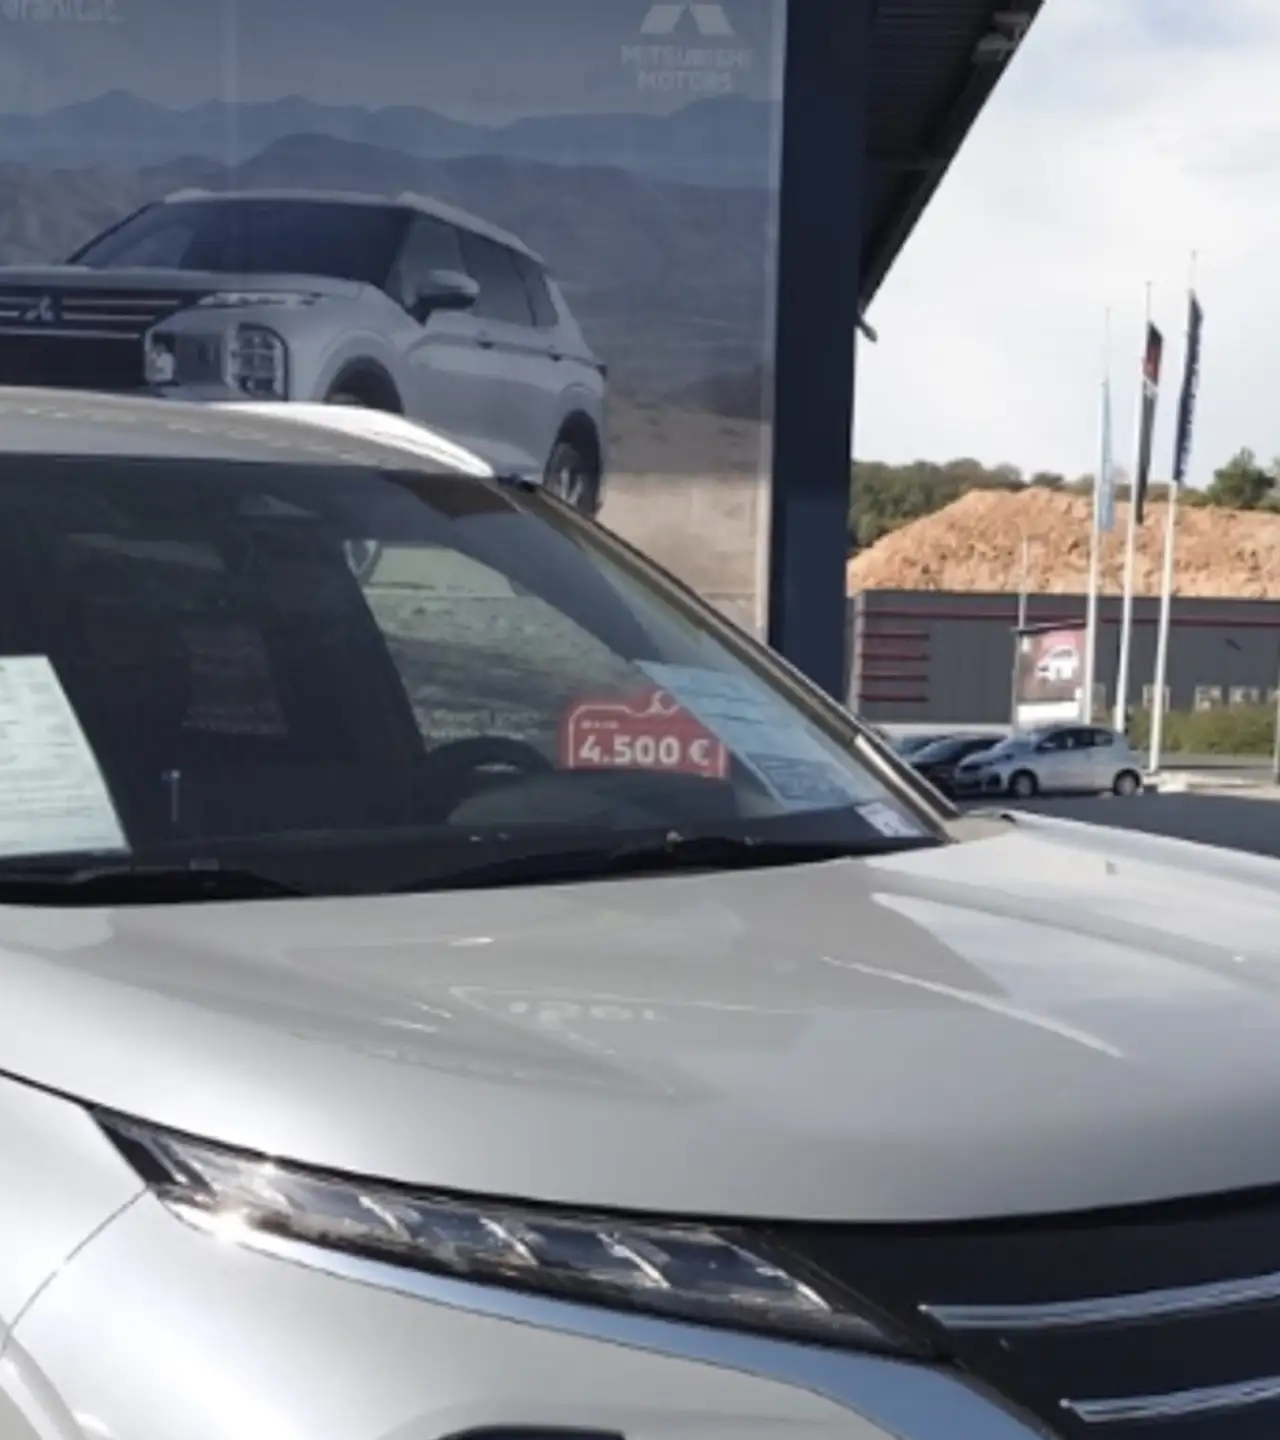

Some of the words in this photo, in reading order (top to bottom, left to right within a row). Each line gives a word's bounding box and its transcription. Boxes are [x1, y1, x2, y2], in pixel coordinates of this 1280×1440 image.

[636, 70, 733, 91] MOTORS
[579, 734, 681, 767] 4.500
[688, 738, 711, 767] €
